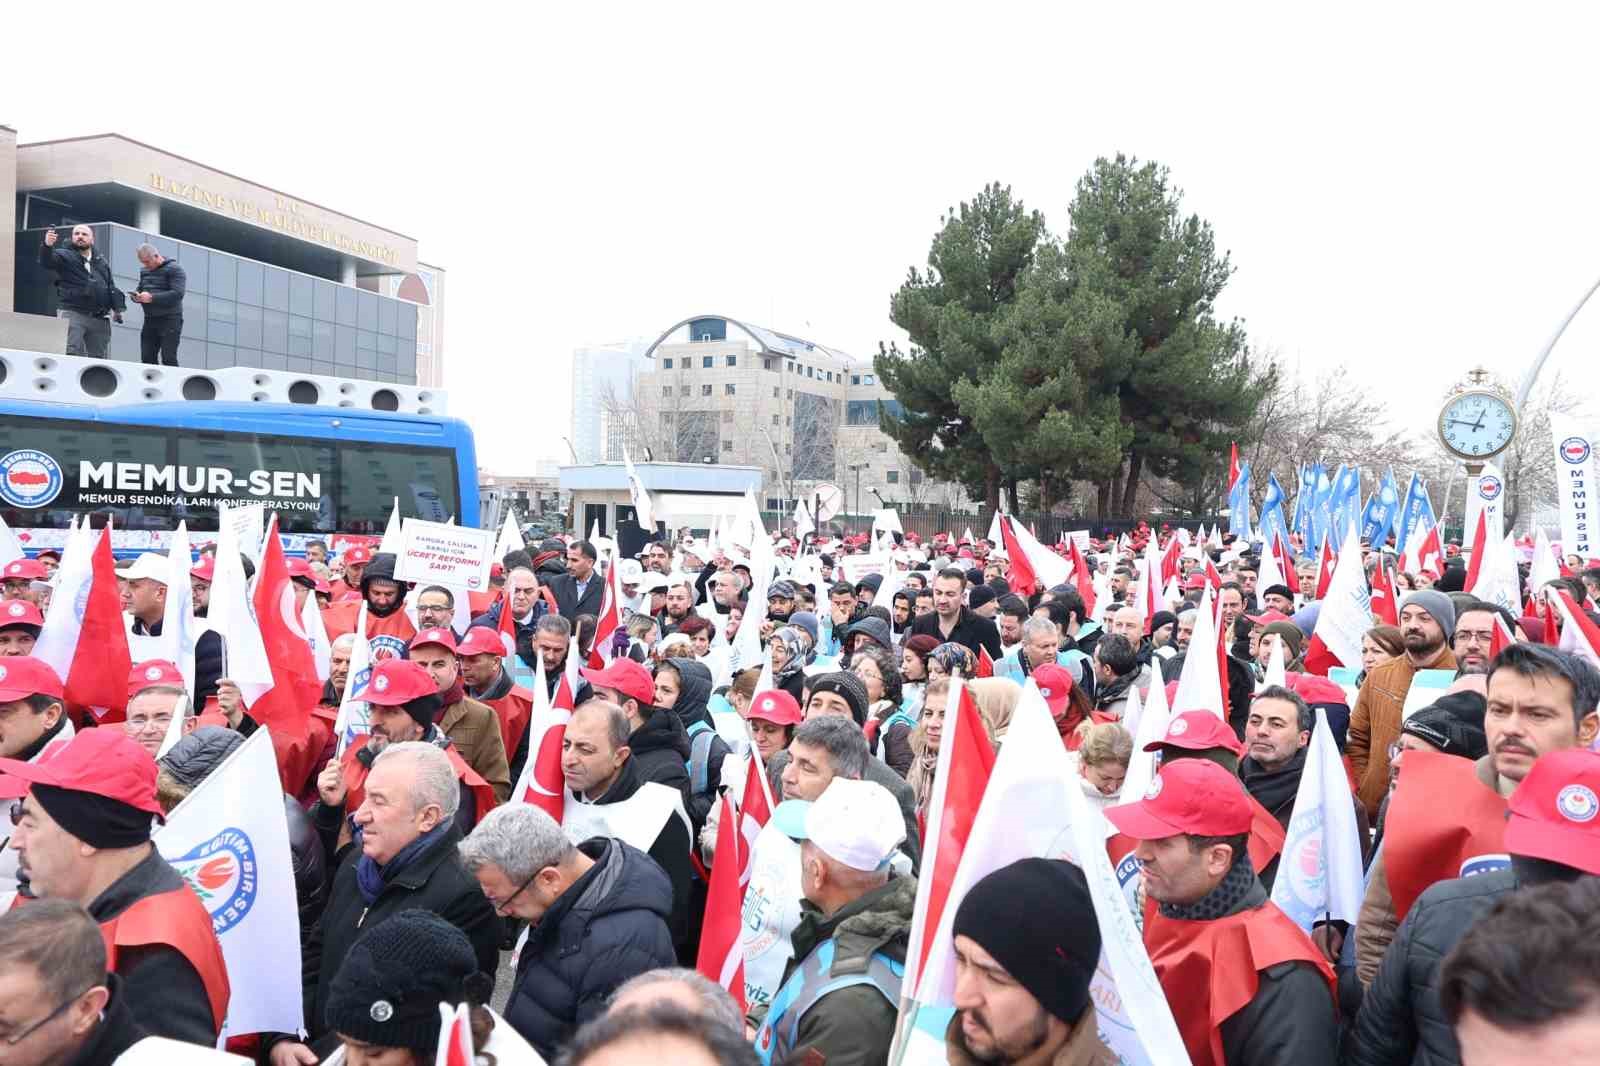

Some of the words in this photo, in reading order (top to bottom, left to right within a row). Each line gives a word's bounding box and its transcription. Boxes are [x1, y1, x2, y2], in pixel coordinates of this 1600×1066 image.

[79, 460, 321, 498] MEMUR-SEN
[79, 493, 126, 504] MEMUR
[129, 494, 211, 507] SENDİKALARI
